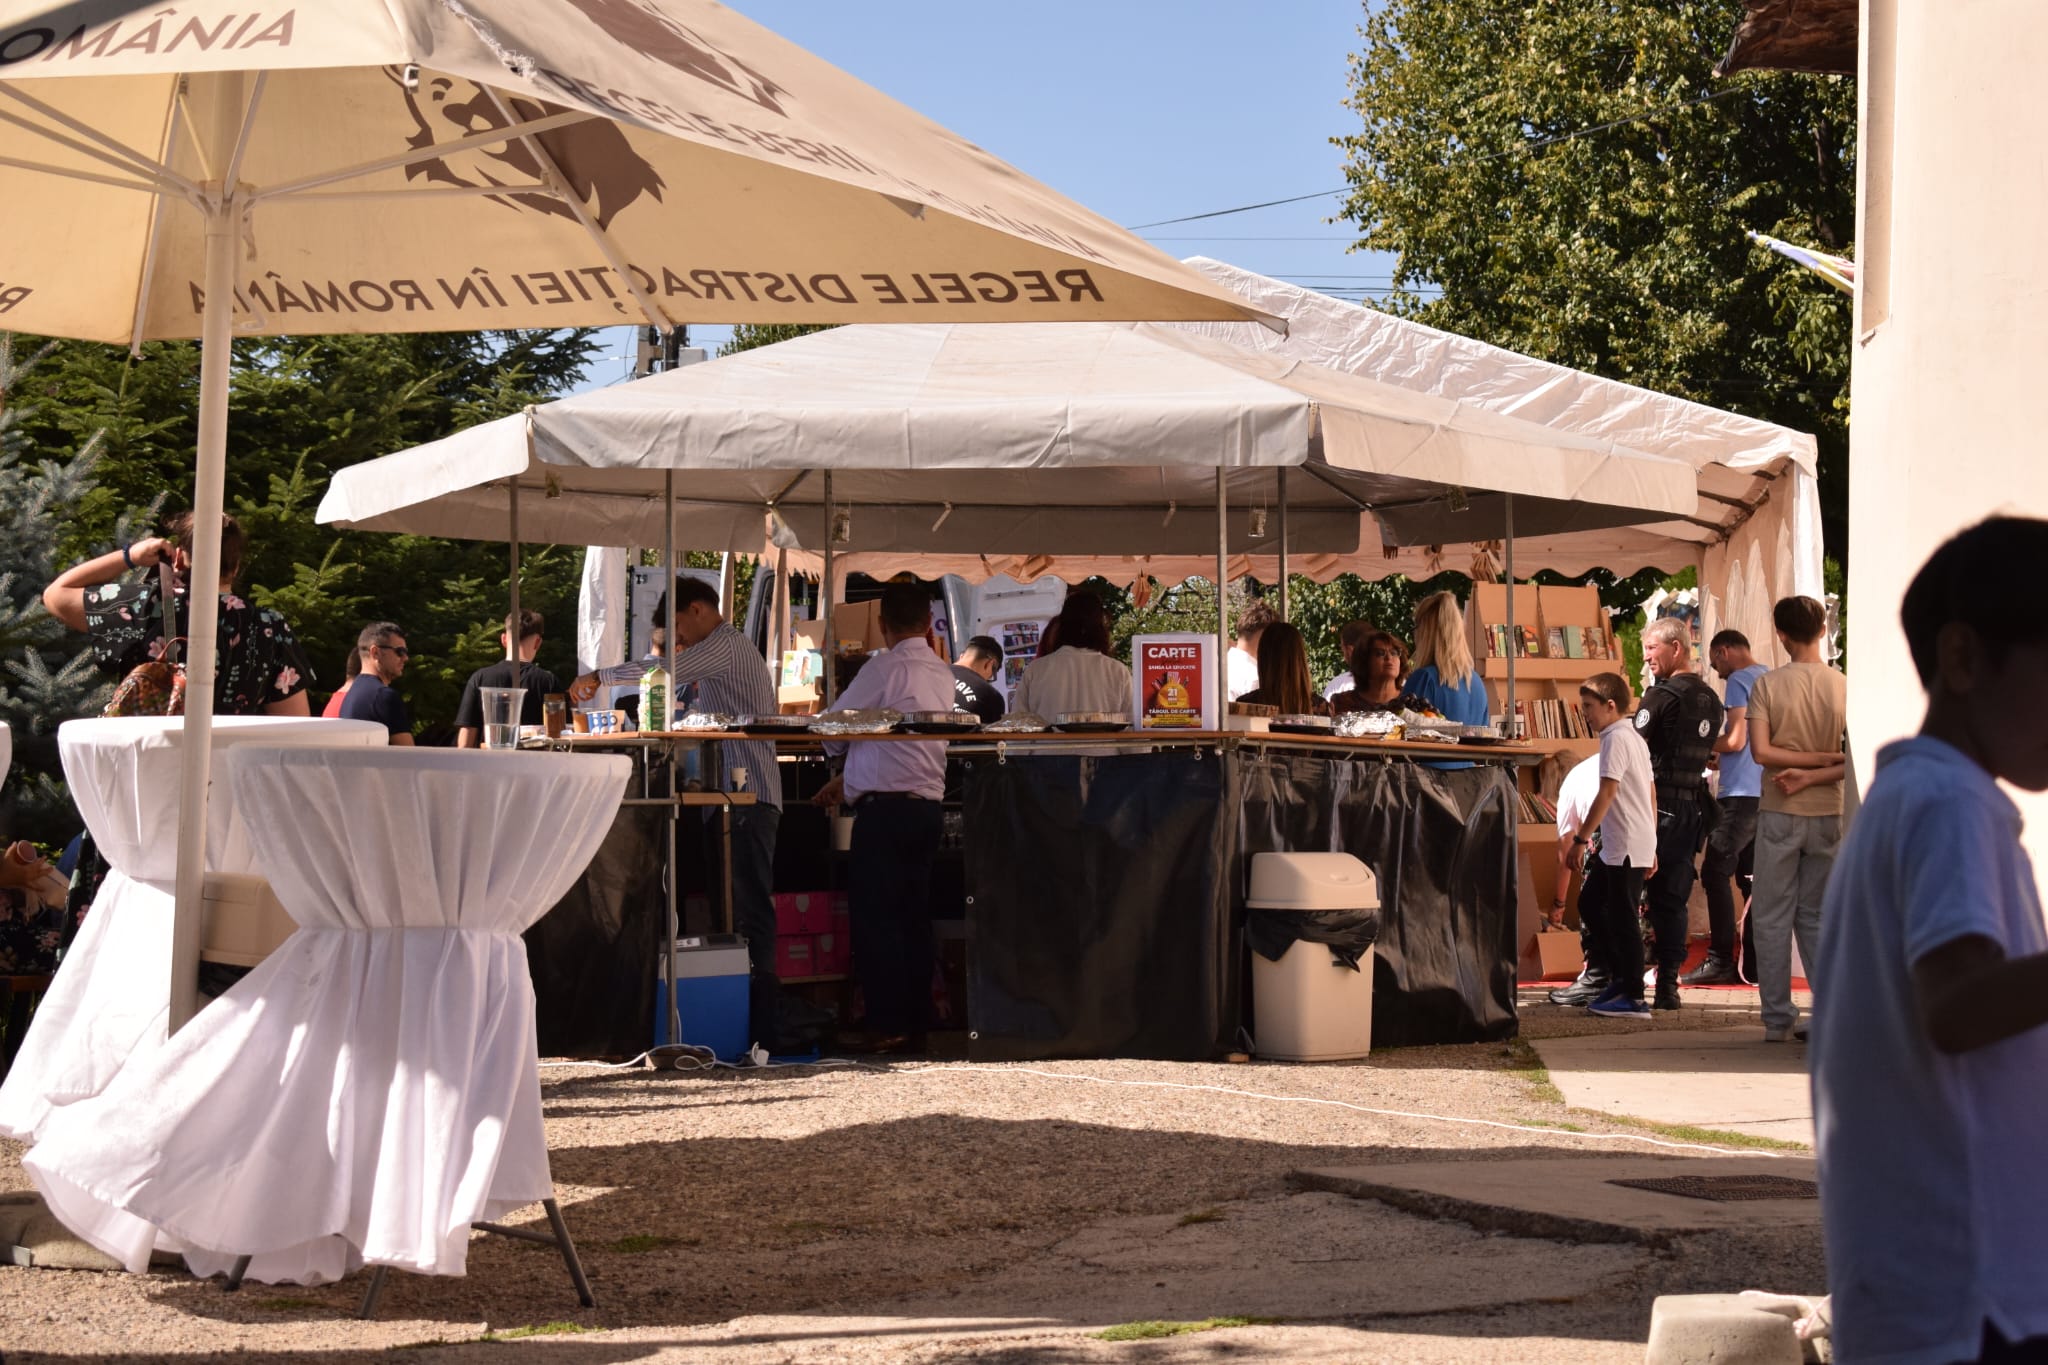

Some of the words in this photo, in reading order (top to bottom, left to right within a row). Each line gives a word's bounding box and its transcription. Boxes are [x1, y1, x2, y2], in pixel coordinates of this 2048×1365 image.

[538, 67, 749, 146] REGELE
[727, 123, 877, 176] BERII
[1148, 647, 1196, 658] CARTE
[955, 679, 977, 702] AVE
[1167, 688, 1178, 697] 21
